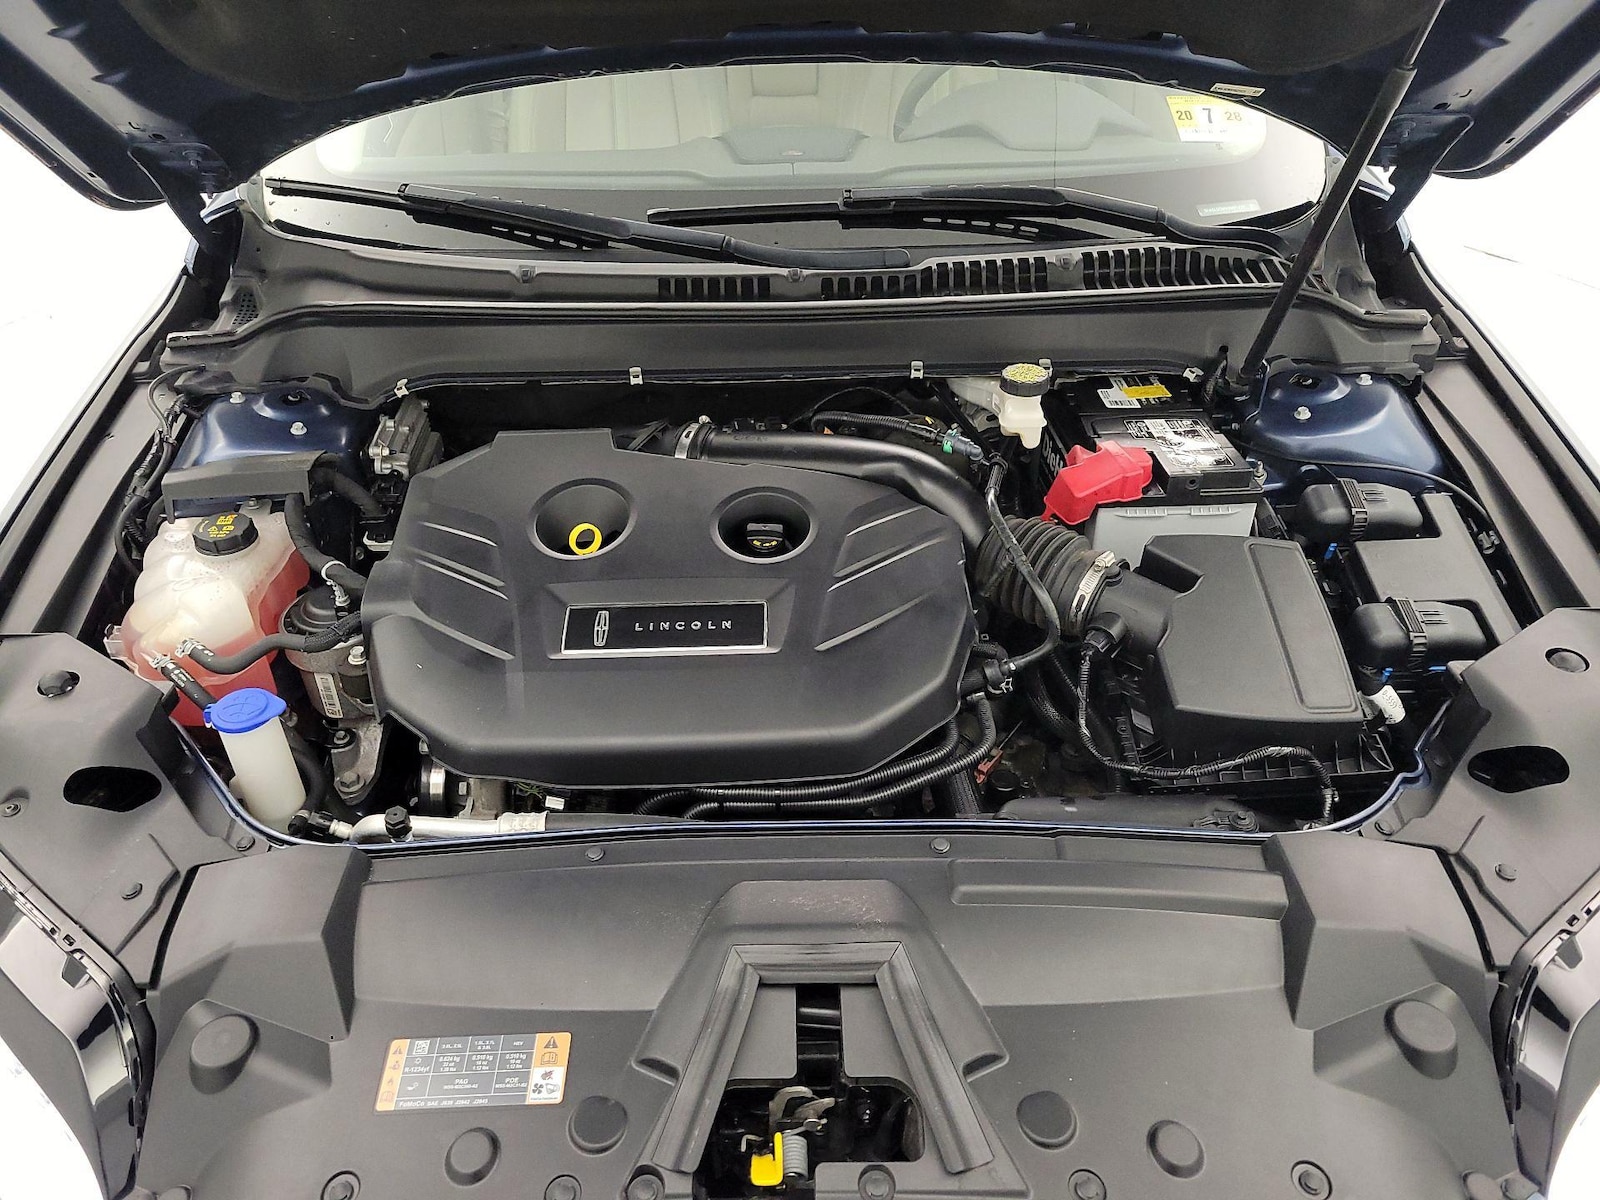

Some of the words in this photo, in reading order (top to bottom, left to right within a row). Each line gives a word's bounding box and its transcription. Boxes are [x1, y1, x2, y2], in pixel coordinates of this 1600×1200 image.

[1176, 110, 1193, 121] 20
[1202, 107, 1213, 124] 7
[635, 620, 732, 632] LINCOLN
